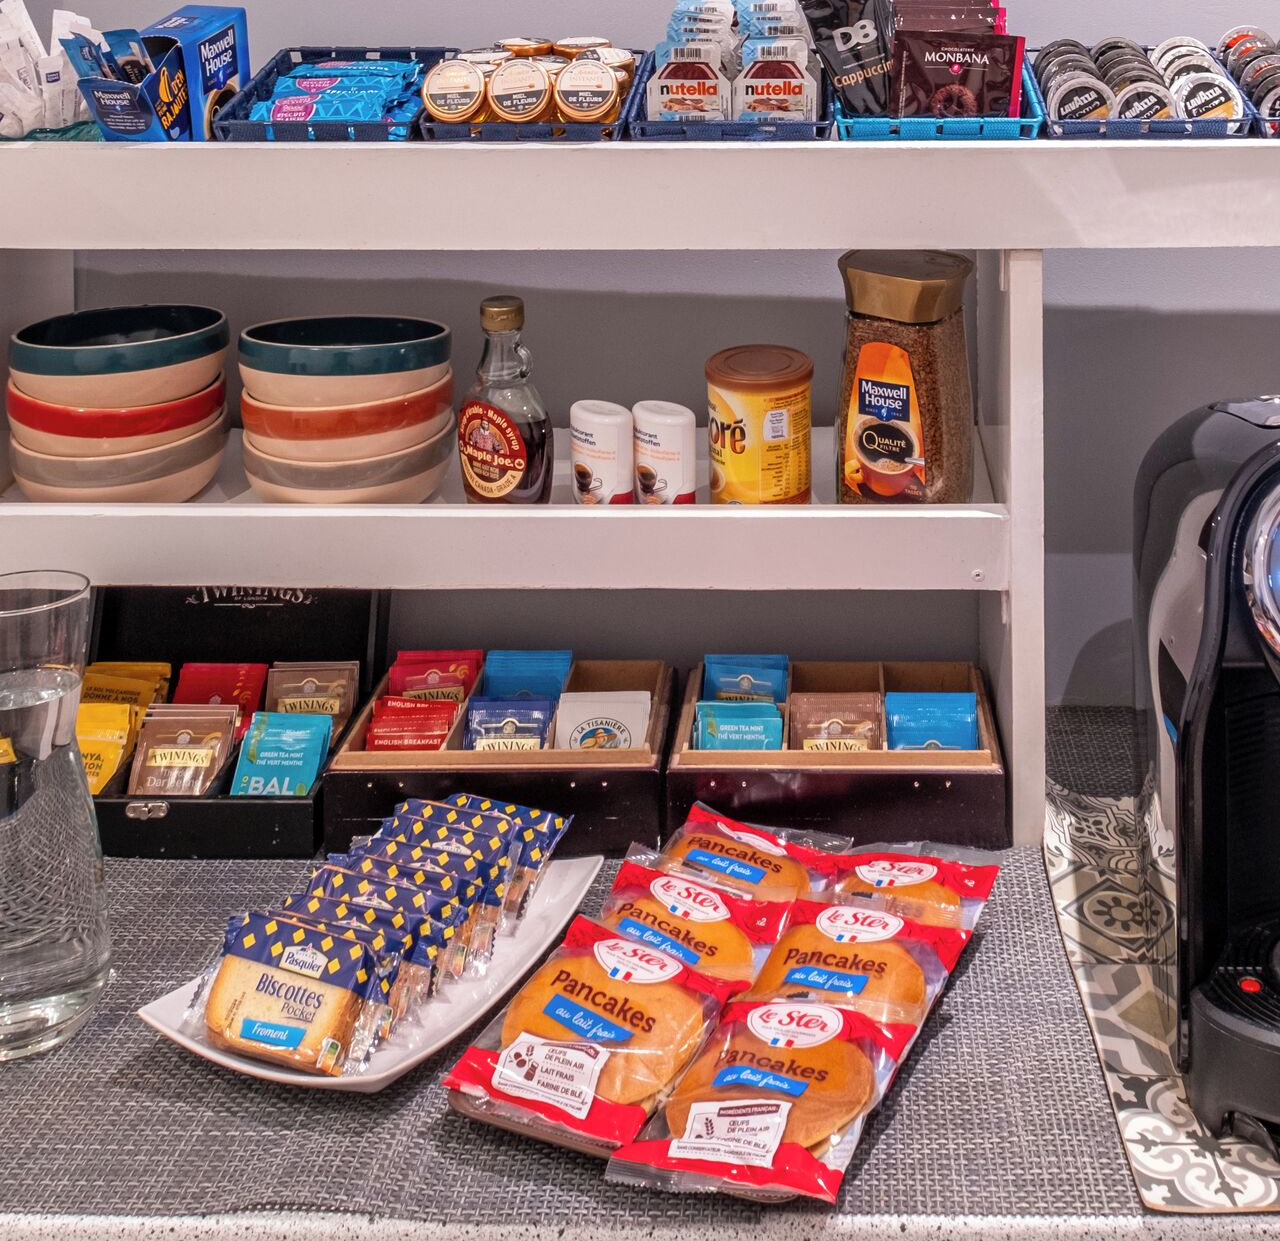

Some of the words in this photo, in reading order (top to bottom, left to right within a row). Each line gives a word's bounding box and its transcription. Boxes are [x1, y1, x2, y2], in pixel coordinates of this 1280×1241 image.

[201, 28, 235, 62] Maxwell
[832, 19, 878, 52] D8
[206, 51, 233, 77] House
[924, 51, 990, 65] MONBANA
[94, 91, 131, 101] Maxwell
[660, 81, 717, 96] nutella
[745, 81, 803, 96] nutella
[1185, 86, 1222, 109] LAVAZZA
[1060, 90, 1098, 116] LAVAZZA
[861, 380, 907, 401] Maxwell
[865, 394, 903, 410] House
[487, 409, 508, 429] Maple
[505, 427, 520, 451] syrup
[862, 430, 907, 454] QUALITÉ
[464, 444, 492, 462] Maple
[493, 454, 513, 468] Joe
[283, 699, 335, 713] TWININGS
[576, 725, 586, 735] LA
[587, 718, 627, 735] TISANIÈRE
[152, 750, 207, 765] TWININGS
[248, 777, 294, 796] BAL
[687, 836, 783, 874] Pancakes
[660, 880, 677, 893] Le
[826, 909, 843, 923] Le
[616, 902, 718, 958] Pancakes
[626, 925, 642, 937] au
[642, 930, 663, 944] lait
[606, 942, 623, 953] Le
[284, 951, 323, 973] Pasquier
[784, 948, 888, 975] Pancakes
[791, 970, 806, 980] au
[808, 970, 828, 985] lait
[824, 974, 854, 989] frais
[256, 972, 324, 1010] Biscottes
[550, 969, 657, 1033] Pancakes
[280, 1001, 318, 1022] Pocket
[759, 1009, 779, 1024] Le
[251, 1022, 289, 1041] Froment
[555, 1006, 572, 1020] au
[571, 1011, 593, 1031] lait
[587, 1022, 616, 1038] frais
[544, 1053, 553, 1062] DE
[554, 1055, 572, 1067] PLEIN
[572, 1060, 585, 1070] AIR
[713, 1047, 829, 1082] Pancakes
[540, 1066, 555, 1077] LAIT
[555, 1070, 575, 1082] FRAIS
[740, 1069, 763, 1081] lait
[758, 1075, 791, 1089] frais
[536, 1080, 560, 1093] FARINE
[560, 1086, 570, 1097] DE
[726, 1126, 737, 1134] DE
